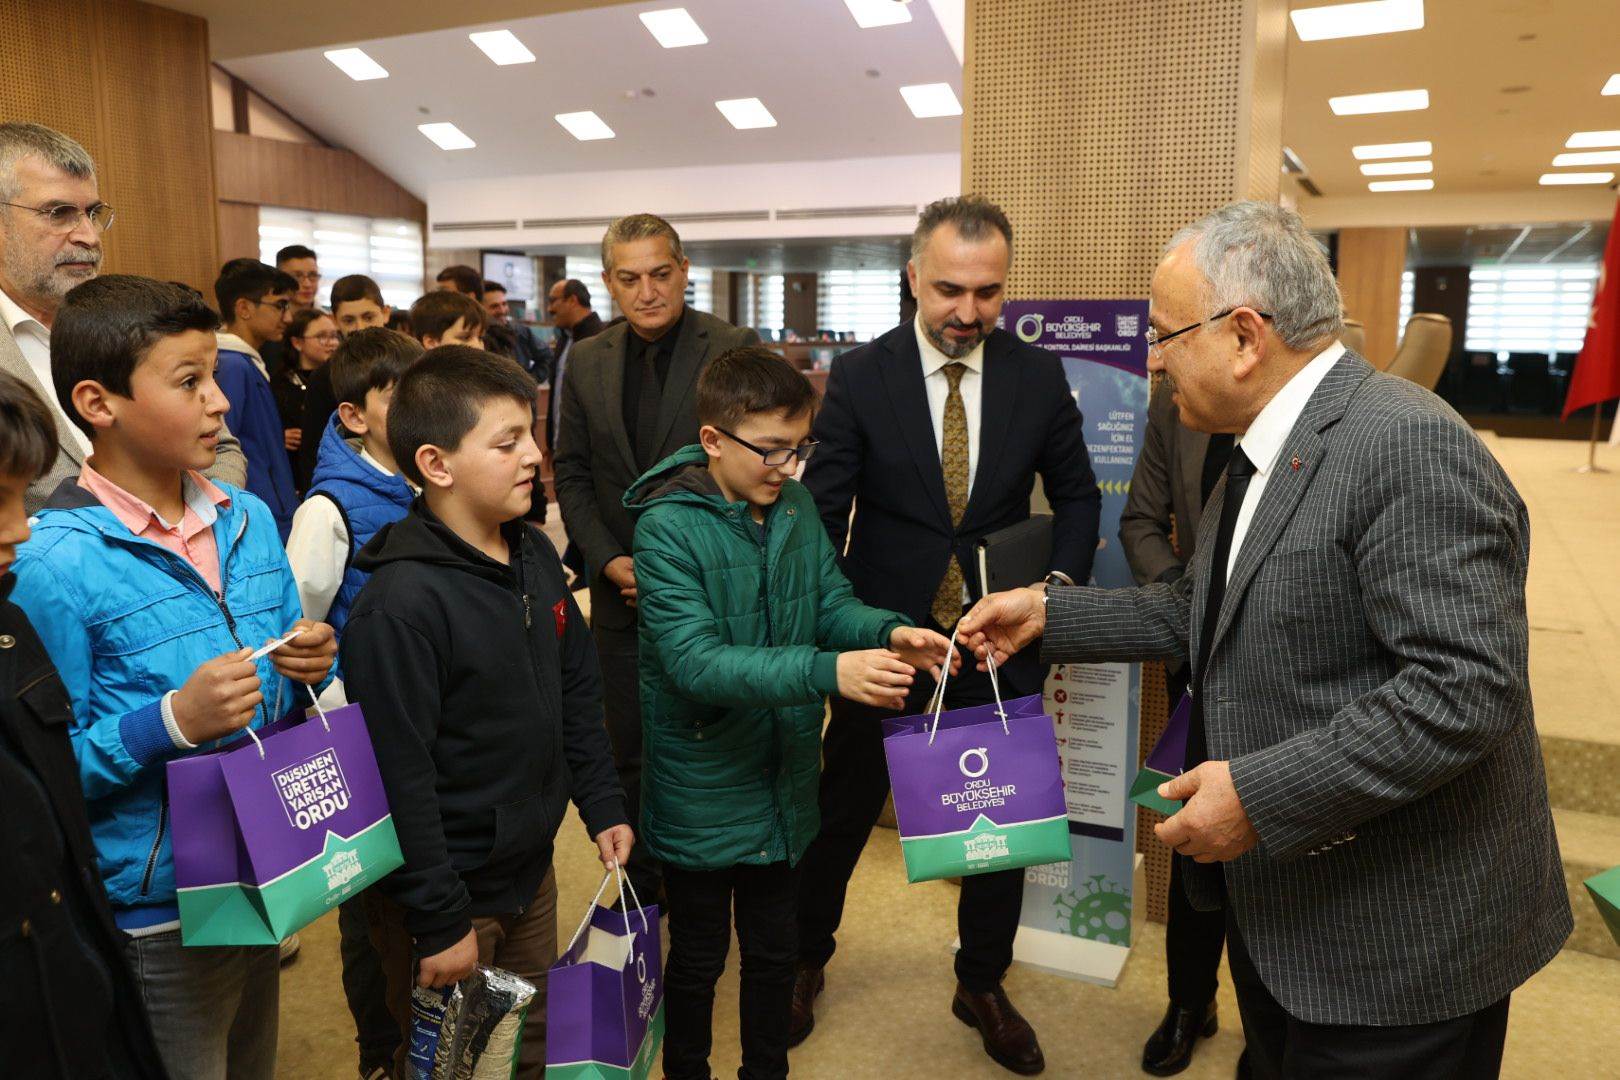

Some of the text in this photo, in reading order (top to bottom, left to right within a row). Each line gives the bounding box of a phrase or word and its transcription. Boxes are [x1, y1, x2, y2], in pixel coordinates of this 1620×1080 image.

[1108, 411, 1134, 421] LÜTFEN
[1125, 433, 1133, 442] EL
[282, 764, 338, 800] ÜRETEN
[964, 779, 991, 790] ORDU
[295, 790, 349, 830] ORDU
[1026, 872, 1068, 889] ORDU
